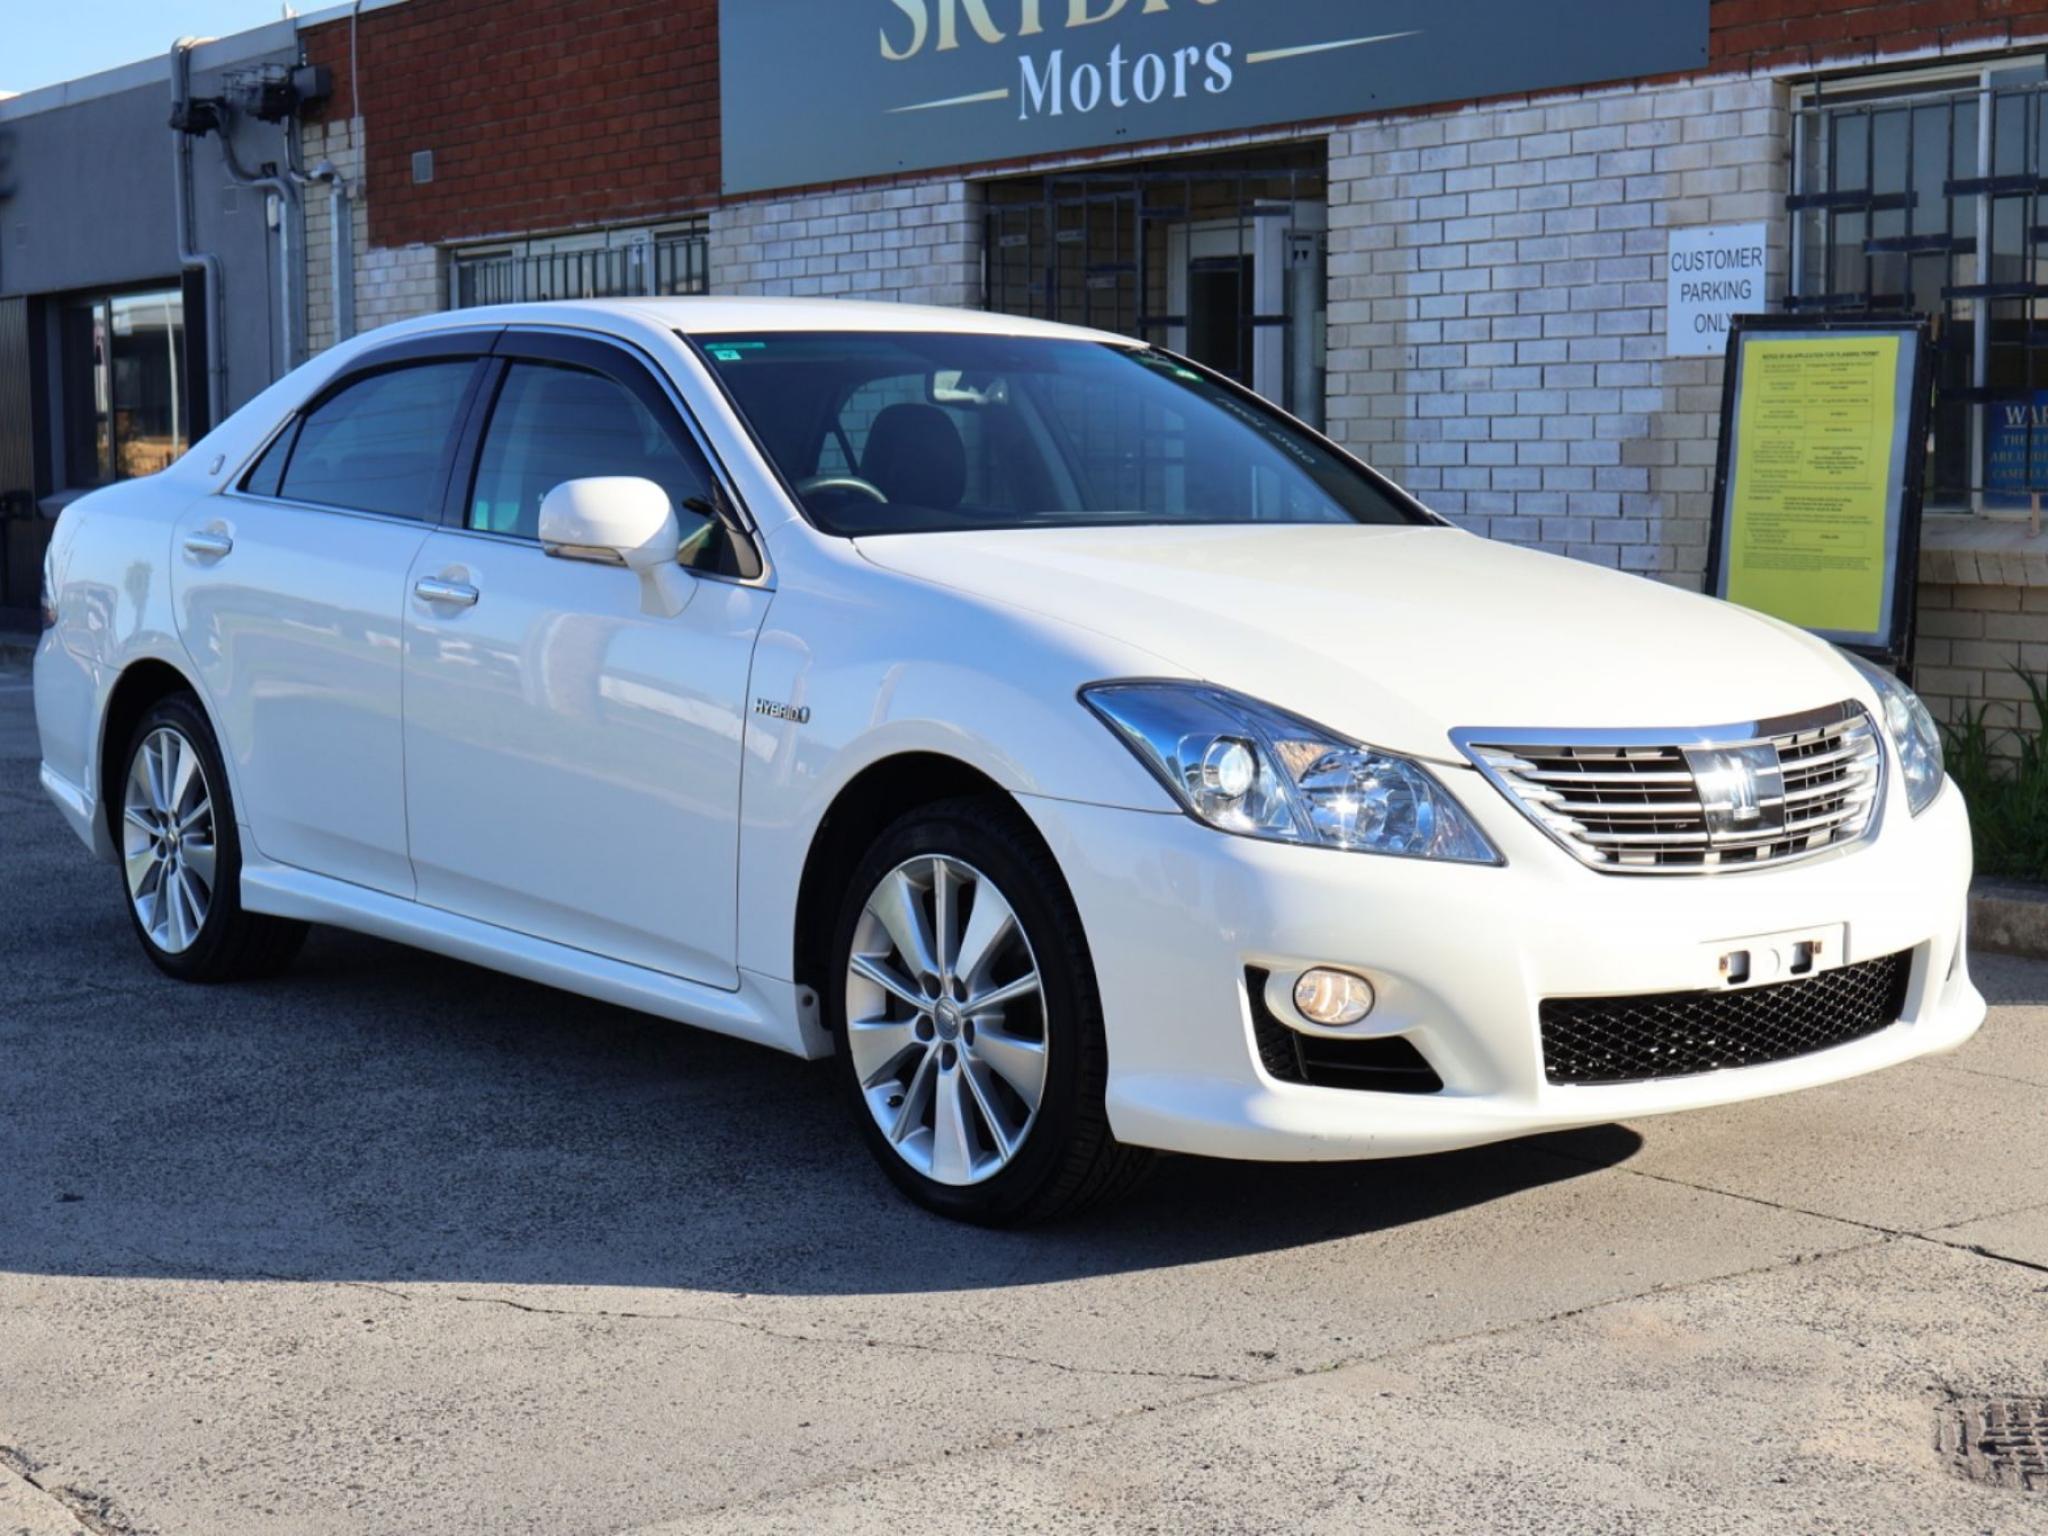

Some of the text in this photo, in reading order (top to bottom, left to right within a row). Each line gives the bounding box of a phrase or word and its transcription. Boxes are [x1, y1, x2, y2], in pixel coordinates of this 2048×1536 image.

[1018, 42, 1233, 120] Motors
[1671, 247, 1763, 272] CUSTOMER
[1680, 279, 1752, 303] PARKING
[754, 698, 800, 722] HYBRID
